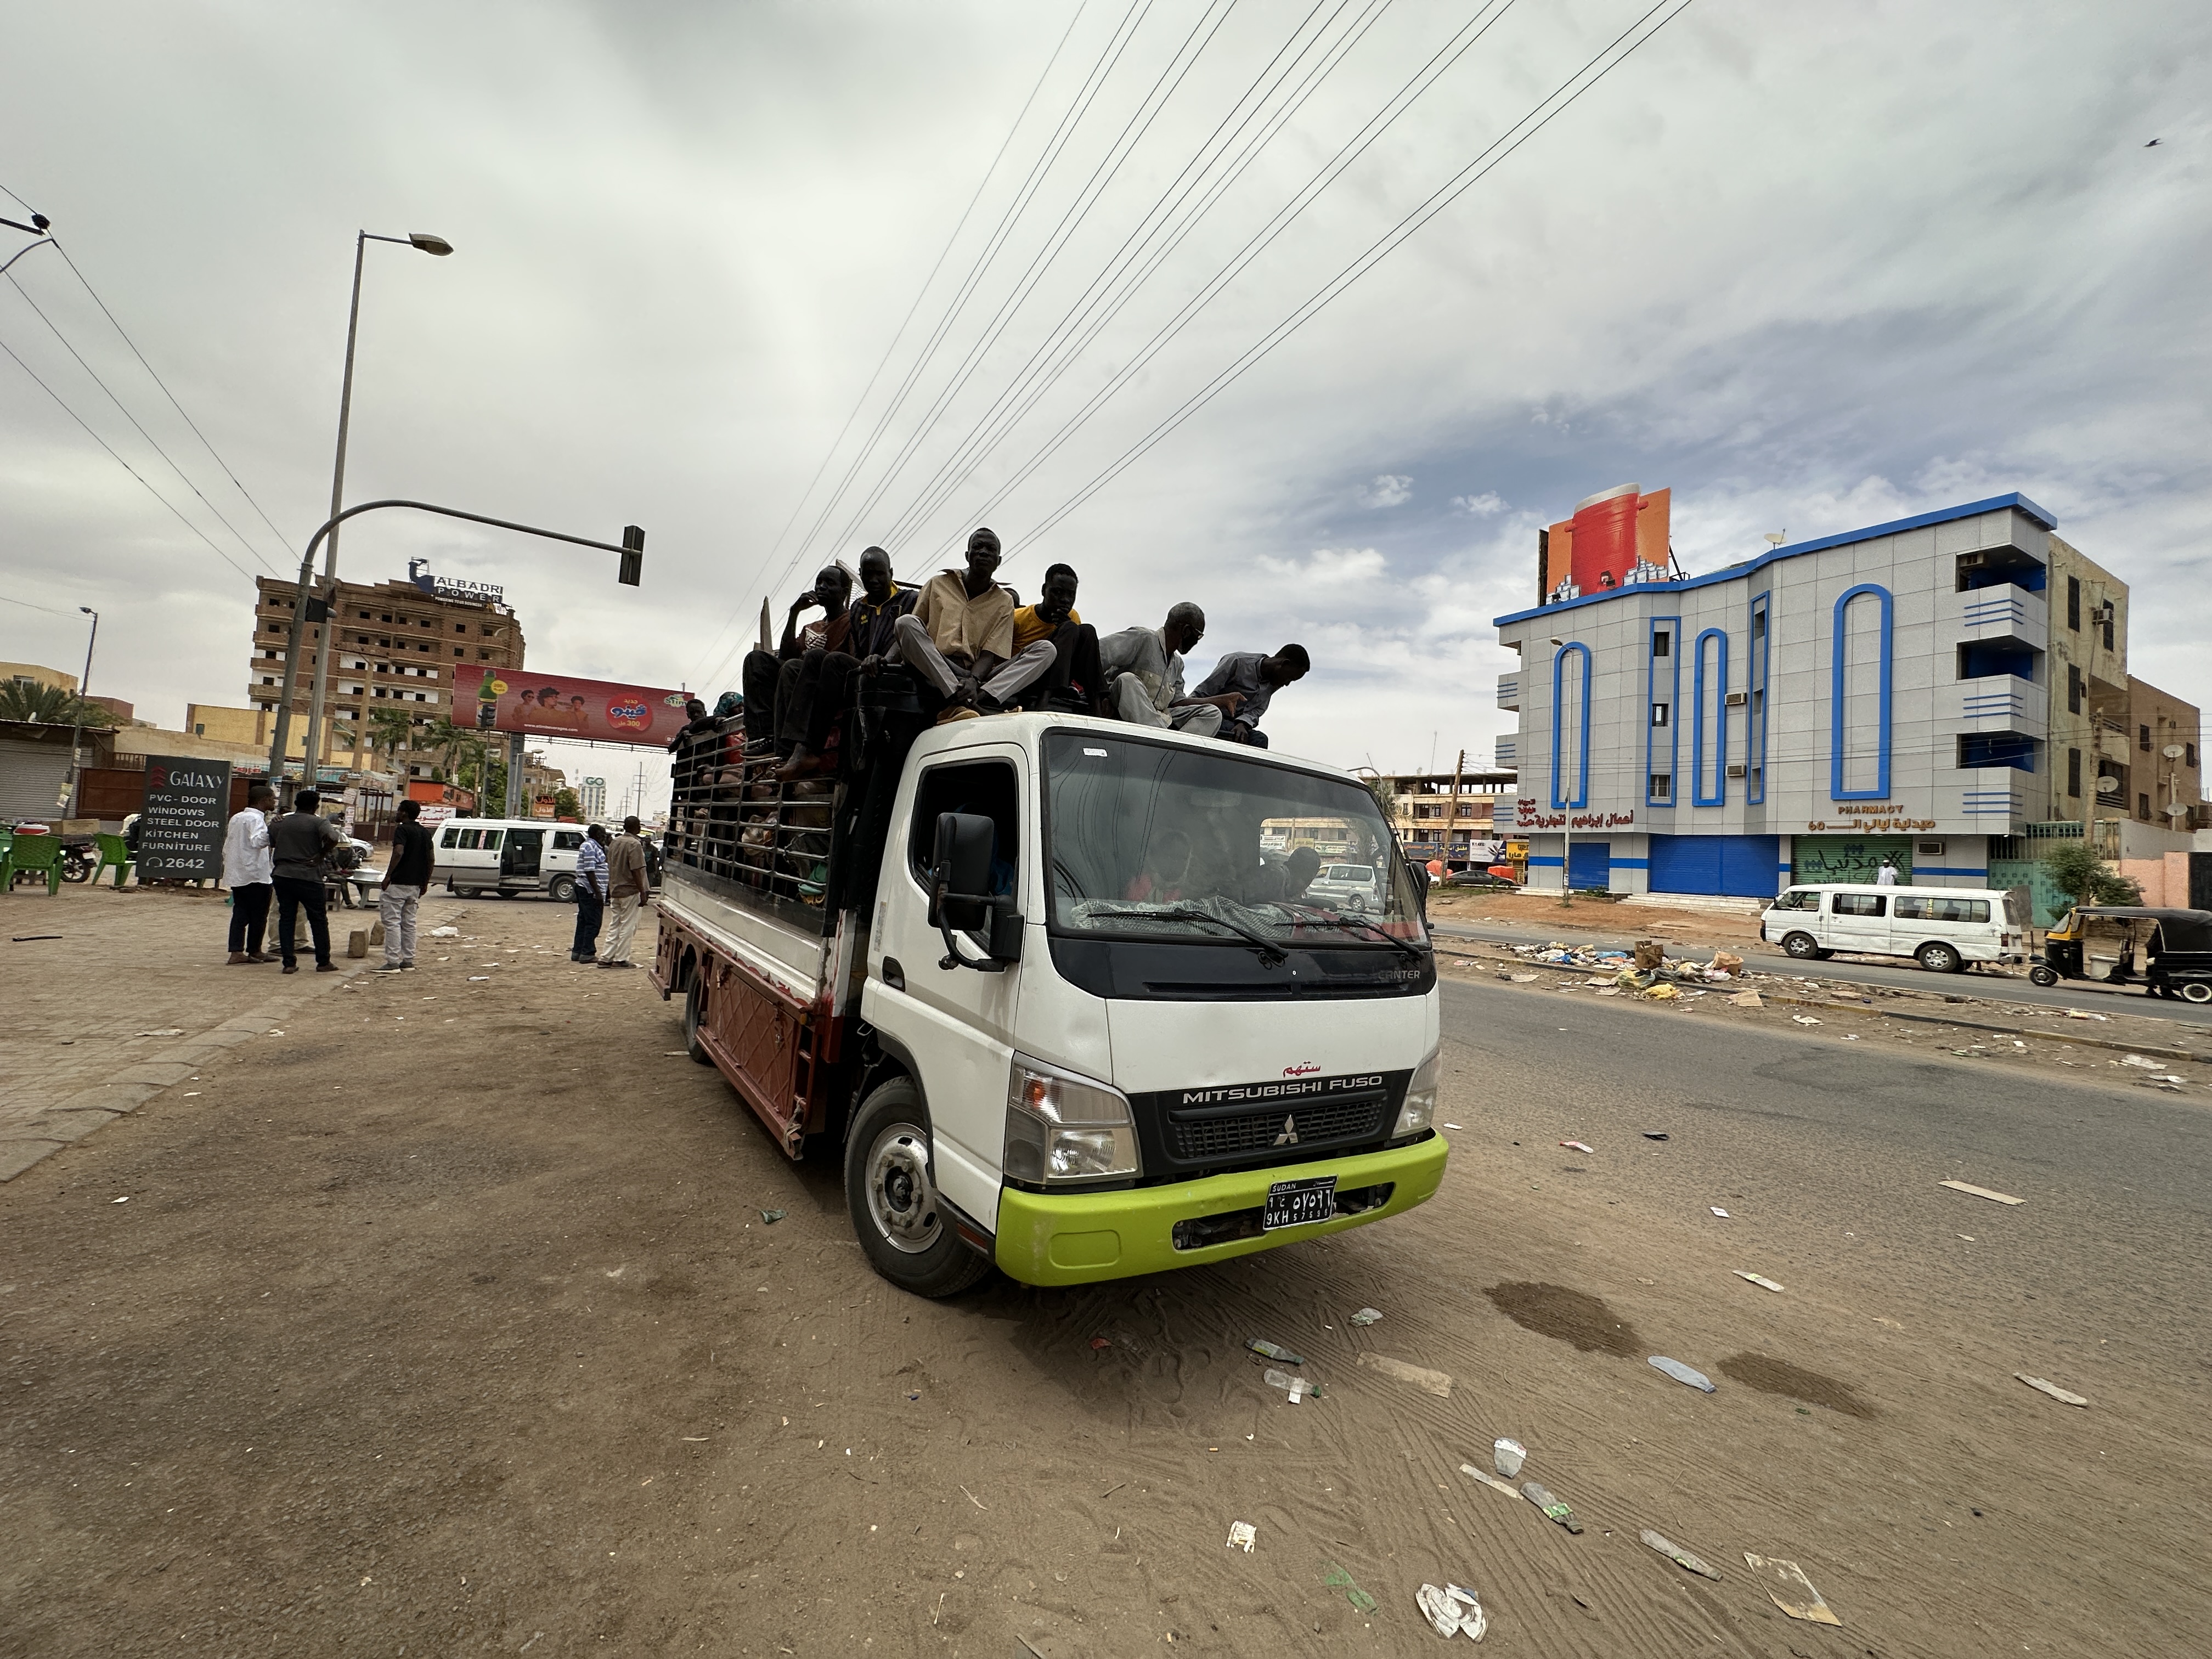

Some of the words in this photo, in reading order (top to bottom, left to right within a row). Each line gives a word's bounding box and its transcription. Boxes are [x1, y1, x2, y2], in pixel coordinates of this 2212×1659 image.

[437, 577, 504, 594] ALBADRI
[438, 587, 500, 602] POWER
[586, 776, 605, 786] GO
[149, 794, 172, 803] PVC
[181, 795, 217, 804] DOOR
[1838, 805, 1904, 815] PHARMACY
[147, 817, 182, 826] STEEL
[185, 819, 219, 828] DOOR
[1534, 814, 1566, 828] لتجارية
[1808, 821, 1825, 831] 60
[1864, 819, 1890, 833] ليالي
[1893, 817, 1936, 831] صيدلية
[166, 858, 205, 869] 2642
[1378, 970, 1421, 979] CANTER
[1183, 1081, 1322, 1104] MITSUBISHI
[1329, 1076, 1383, 1091] FUSO
[1272, 1183, 1296, 1192] SUDAN
[1266, 1209, 1289, 1226] 9KH
